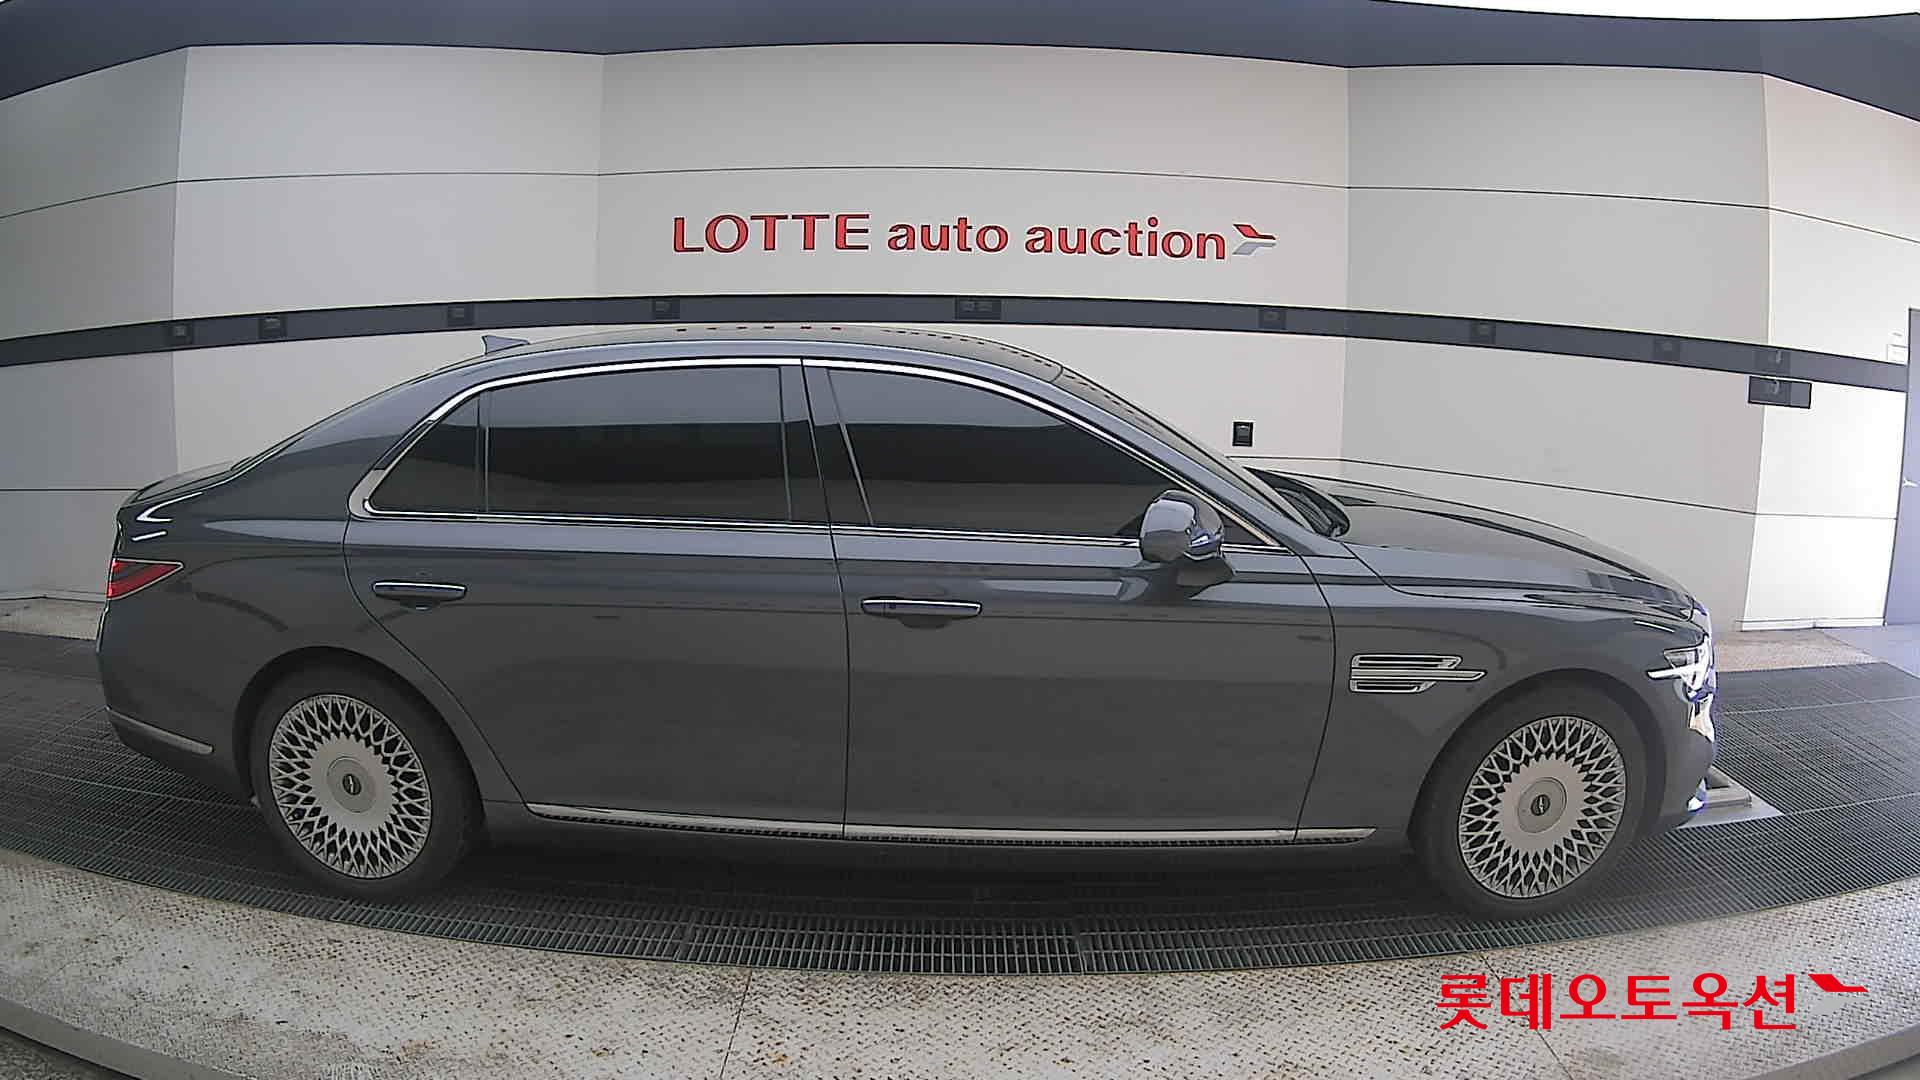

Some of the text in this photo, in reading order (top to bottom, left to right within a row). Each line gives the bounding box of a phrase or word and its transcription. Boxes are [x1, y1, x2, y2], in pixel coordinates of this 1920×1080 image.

[673, 214, 1226, 260] LOTTE auto auction
